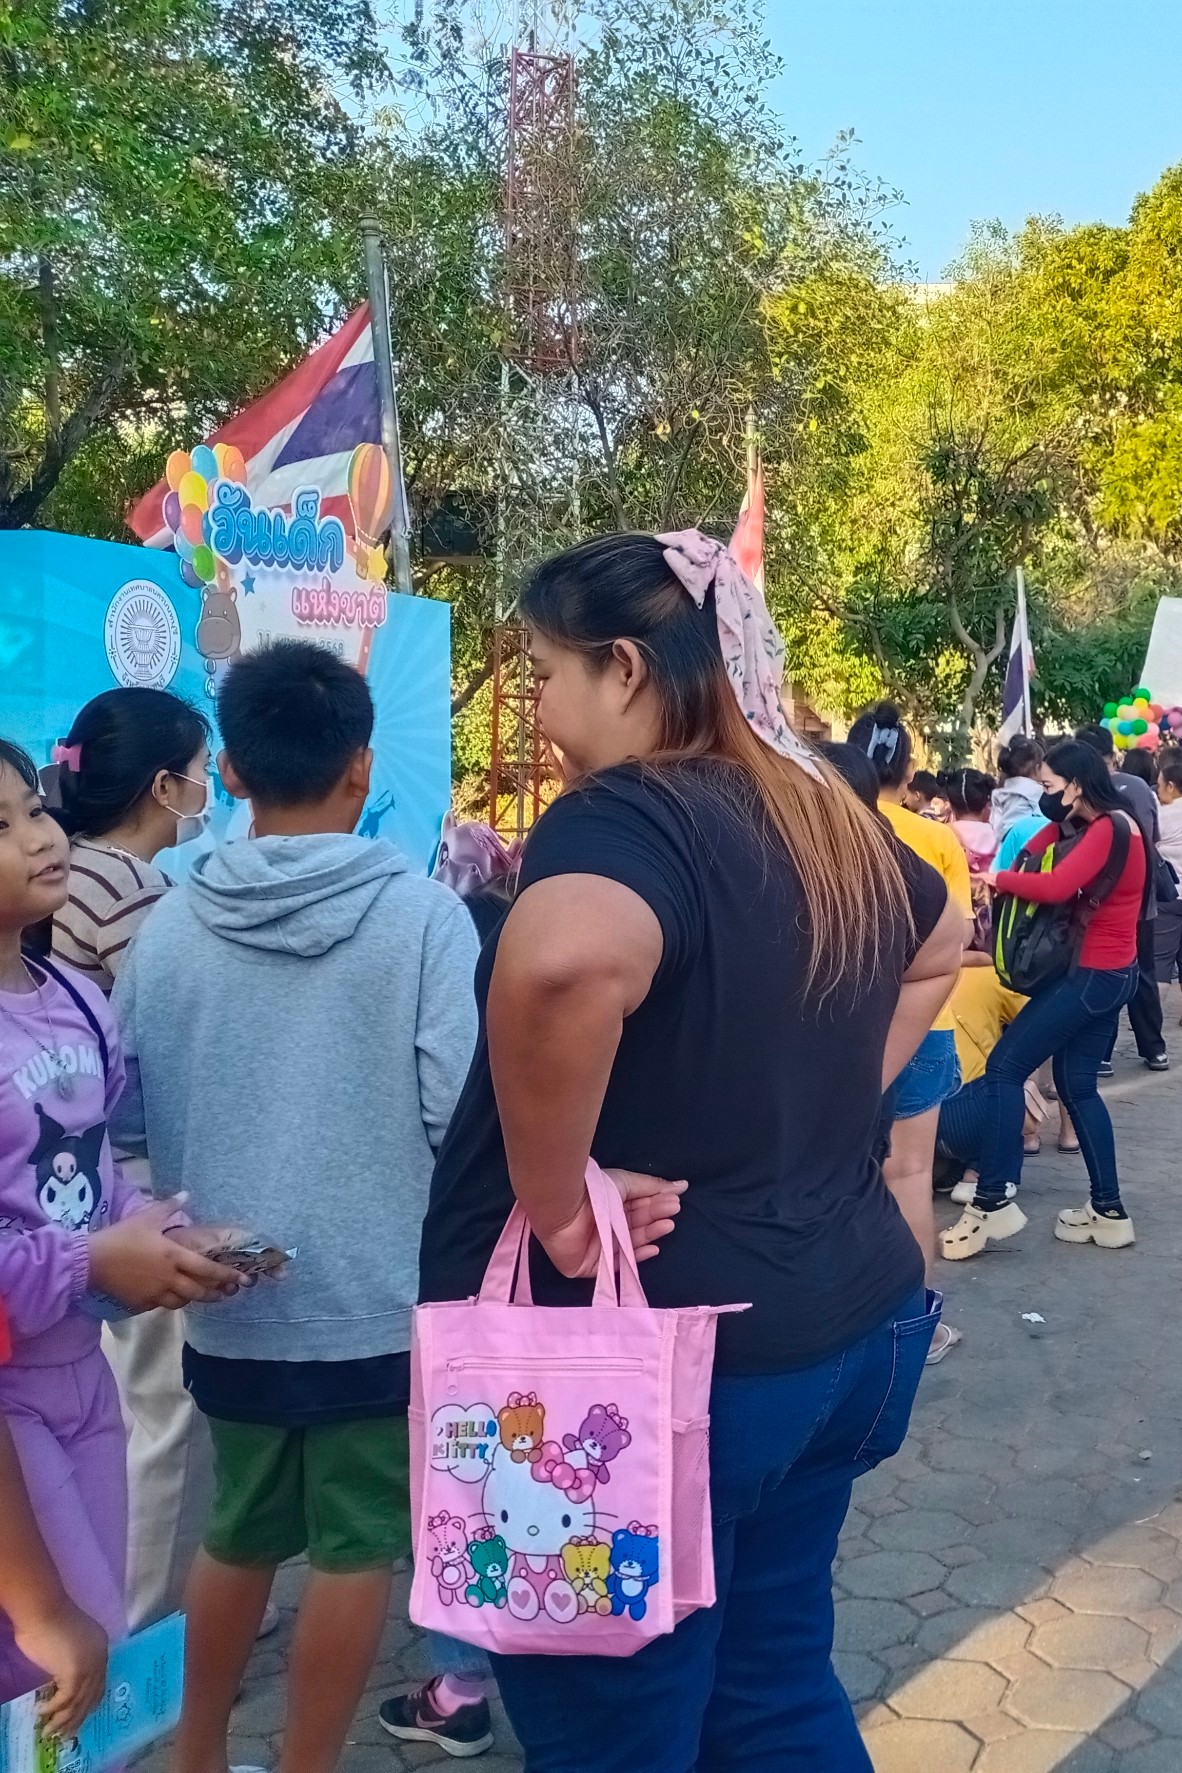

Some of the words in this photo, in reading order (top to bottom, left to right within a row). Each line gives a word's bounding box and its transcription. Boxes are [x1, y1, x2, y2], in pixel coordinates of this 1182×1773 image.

[211, 482, 345, 573] วันเด็ก
[292, 577, 387, 626] แห่งชาติ
[445, 1420, 497, 1438] HELLO
[432, 1440, 489, 1459] KITTY
